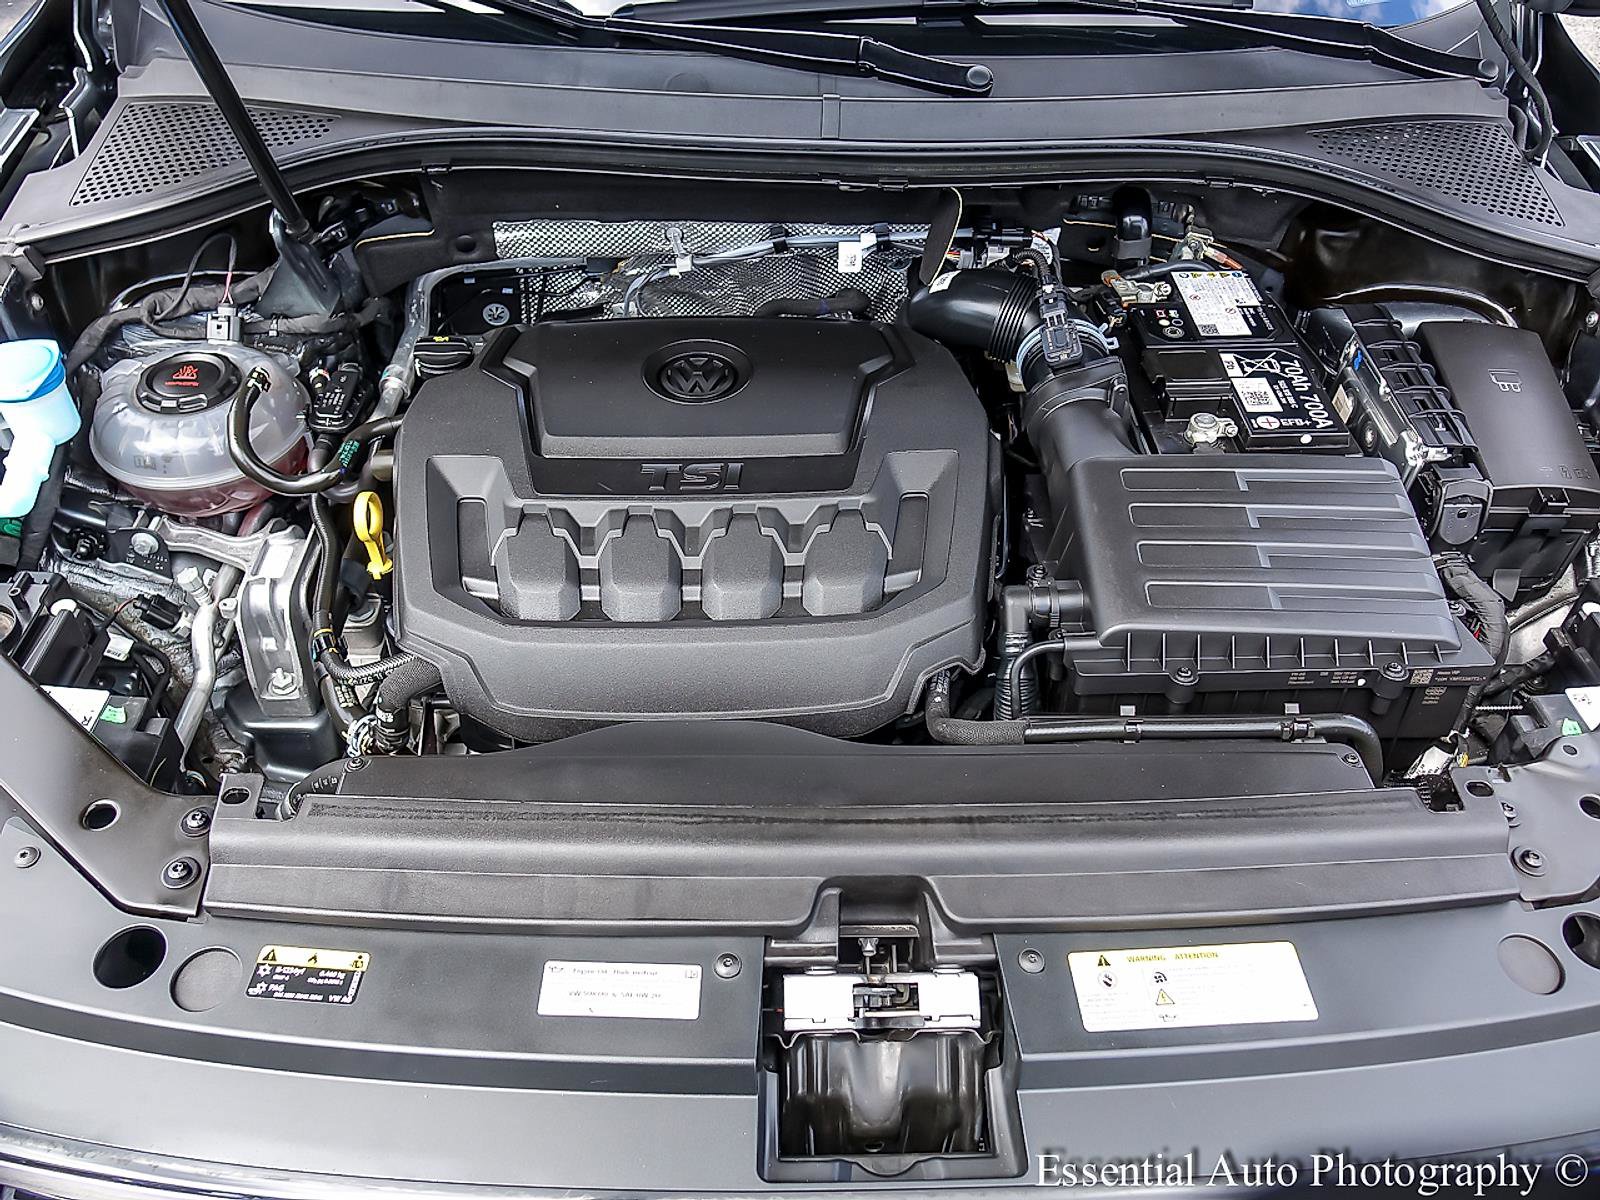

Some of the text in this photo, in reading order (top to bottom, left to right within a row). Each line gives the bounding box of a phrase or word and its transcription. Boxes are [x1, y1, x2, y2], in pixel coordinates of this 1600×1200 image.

[660, 352, 736, 400] VW
[1280, 359, 1312, 391] 70Ah
[1300, 393, 1334, 429] 700A
[640, 462, 744, 491] TSI
[1126, 951, 1219, 964] WARNING ATTENTION
